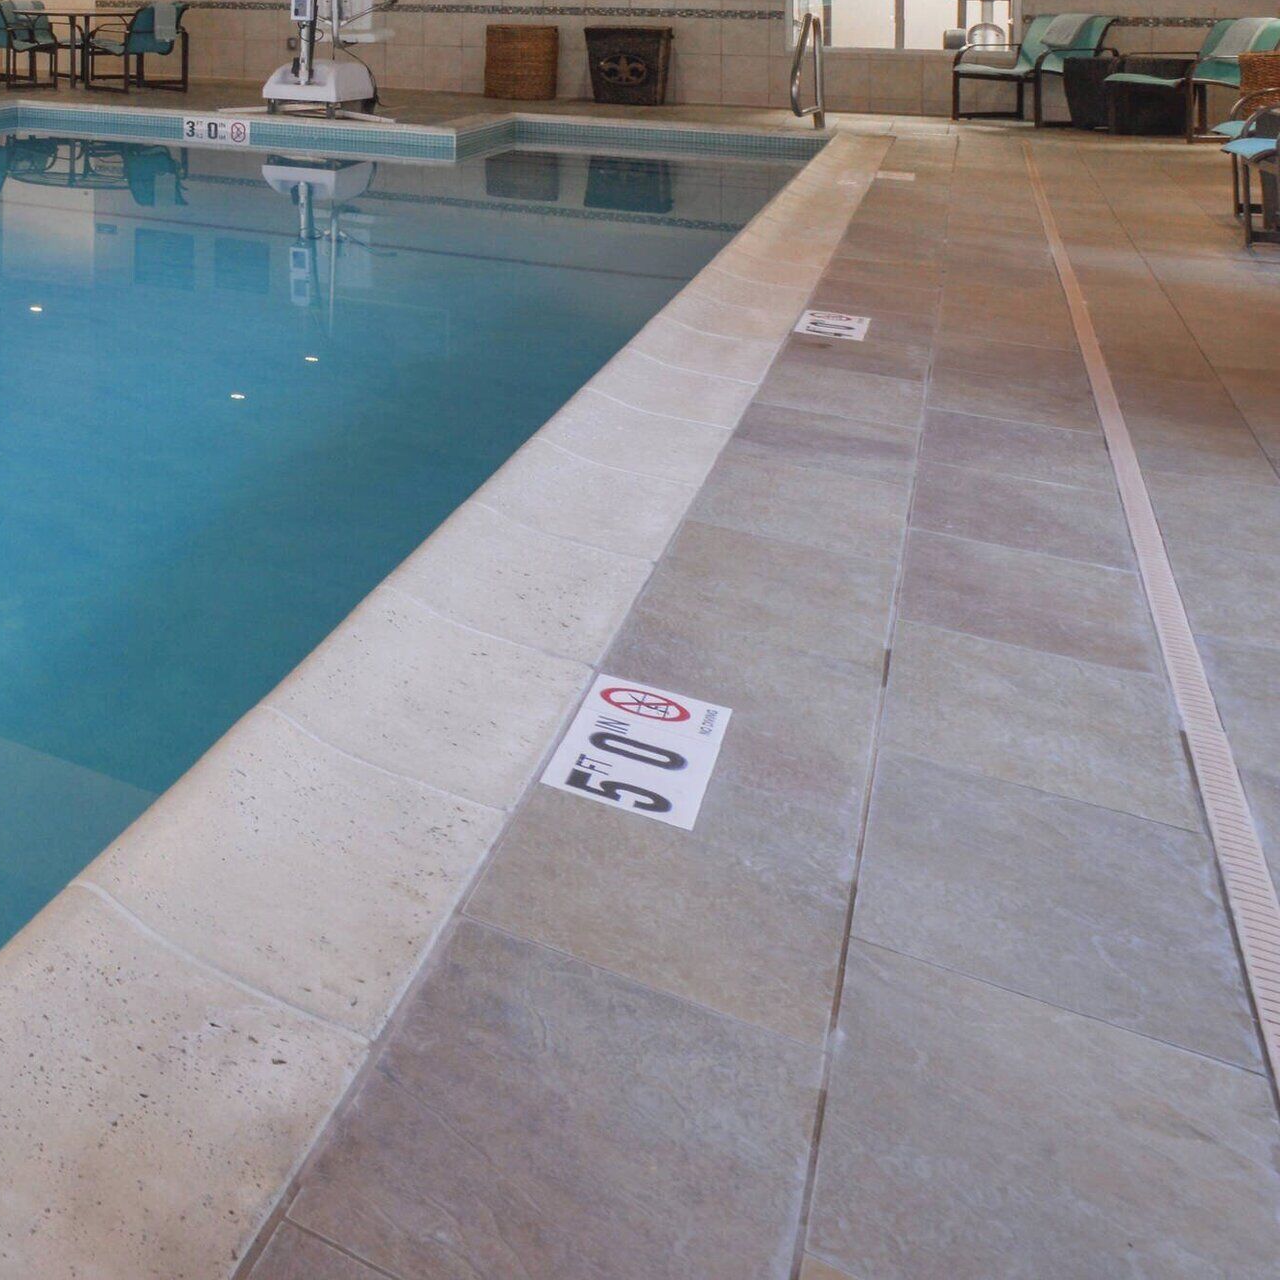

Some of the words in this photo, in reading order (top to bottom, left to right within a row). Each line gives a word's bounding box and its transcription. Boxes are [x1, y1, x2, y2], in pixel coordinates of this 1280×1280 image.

[186, 120, 196, 137] 3
[594, 715, 630, 735] IN
[589, 731, 689, 771] 0
[575, 753, 613, 776] FT
[565, 767, 673, 813] 5
